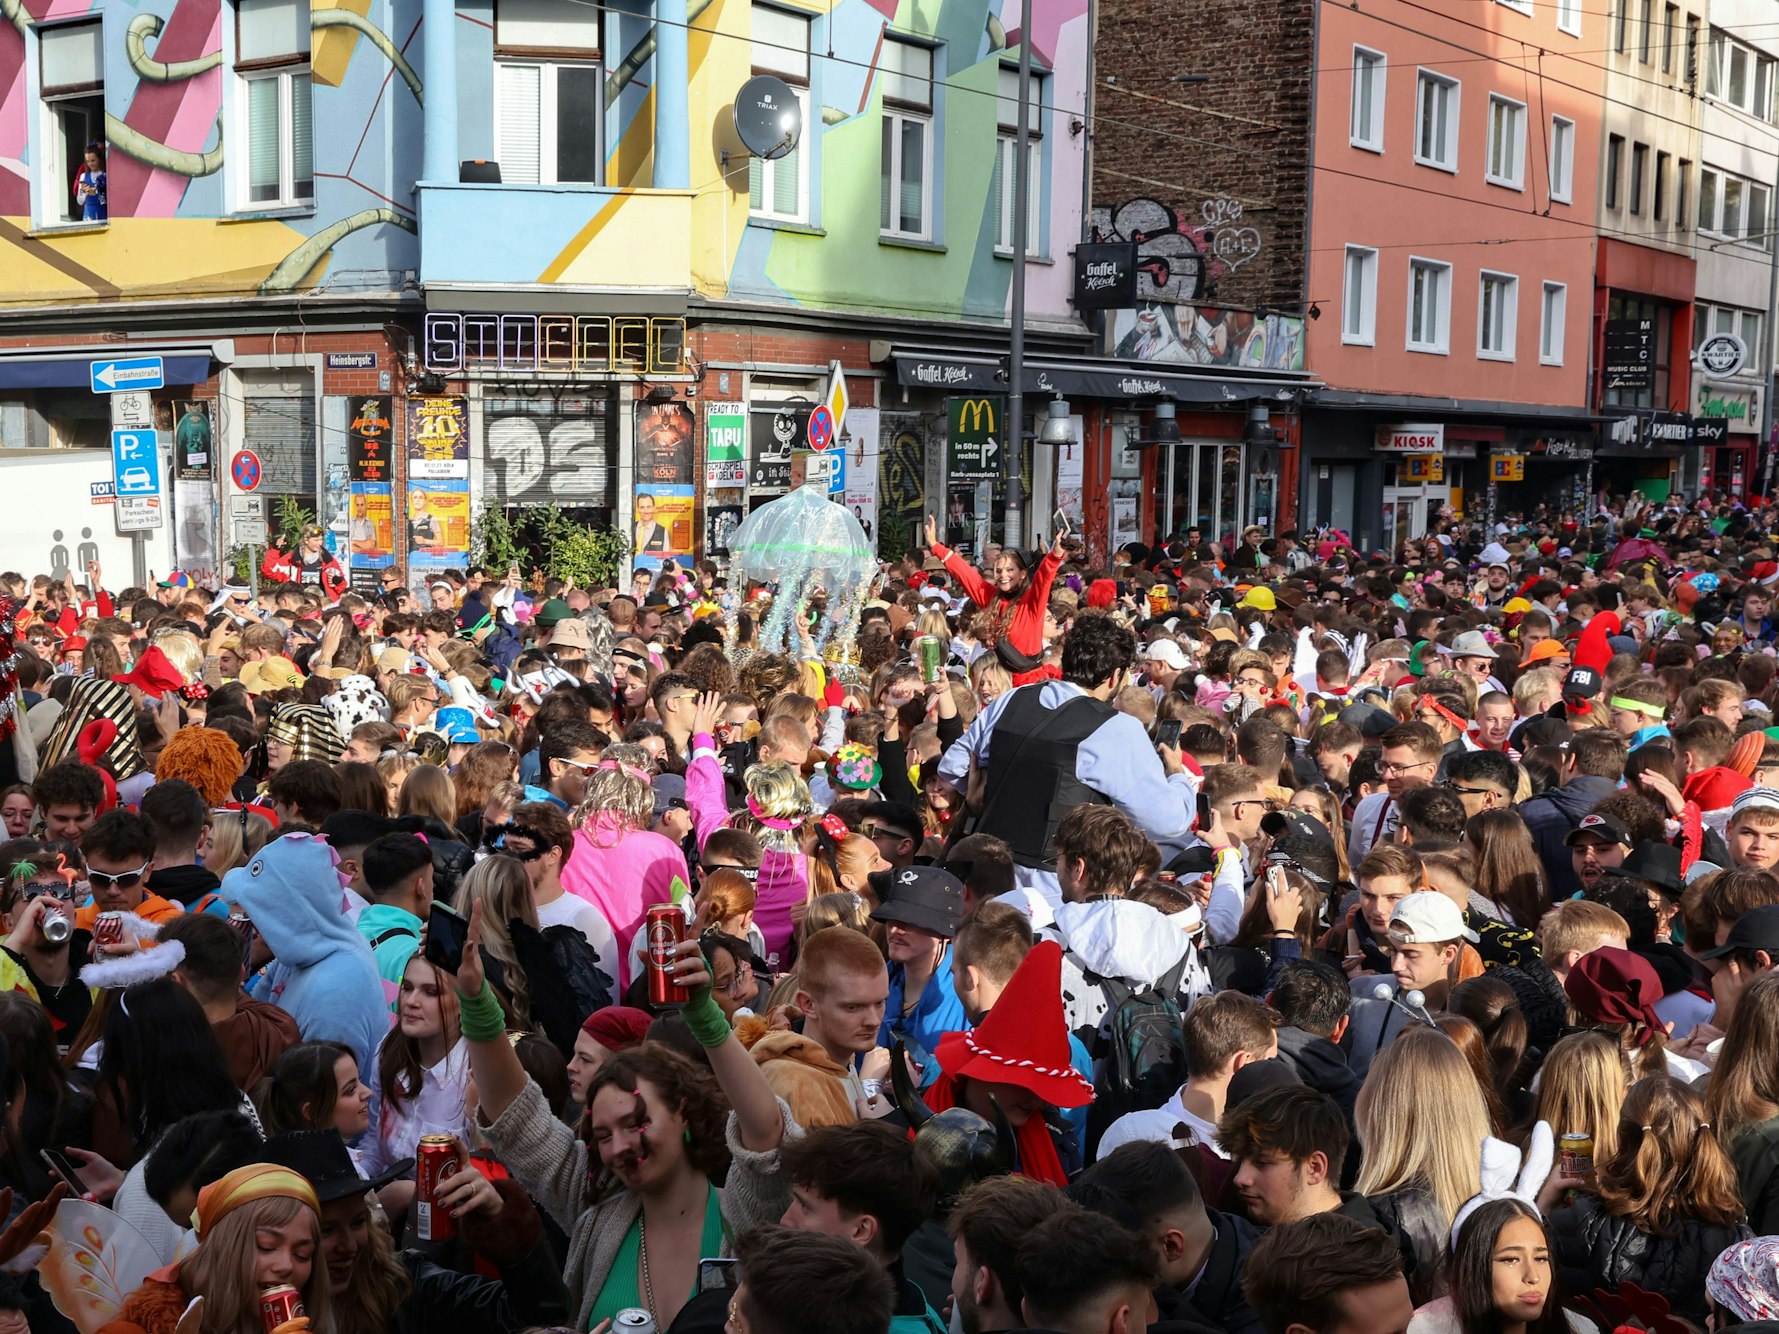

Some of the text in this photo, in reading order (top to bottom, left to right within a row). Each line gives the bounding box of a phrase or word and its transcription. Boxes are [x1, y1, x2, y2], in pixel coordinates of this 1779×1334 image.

[756, 101, 778, 111] TRIAX
[1086, 261, 1117, 277] Gaffel
[1085, 274, 1117, 290] Kölsch
[430, 319, 684, 369] STIEFEL
[329, 355, 372, 368] Heinsbergstr.
[112, 369, 159, 380] Einbahnstraße
[917, 363, 968, 384] Gaffel Kölsch
[424, 399, 454, 408] DEINE
[710, 404, 729, 414] READY
[730, 404, 739, 414] TO
[416, 406, 462, 417] FREUNDE
[416, 415, 461, 440] 10
[1696, 424, 1723, 440] sky
[710, 427, 742, 448] TABU
[1393, 436, 1436, 449] KIOSK
[119, 434, 140, 461] P
[955, 442, 963, 450] in
[957, 452, 980, 460] rechts
[1568, 448, 1593, 459] DELIVERY
[653, 467, 678, 478] KÖLN
[708, 461, 744, 471] SCHAUSPIEL
[829, 454, 842, 489] P
[1411, 458, 1429, 476] EC
[1495, 460, 1511, 477] EC
[715, 471, 734, 481] KOELN
[91, 483, 110, 495] TOI
[1571, 670, 1592, 685] FBI
